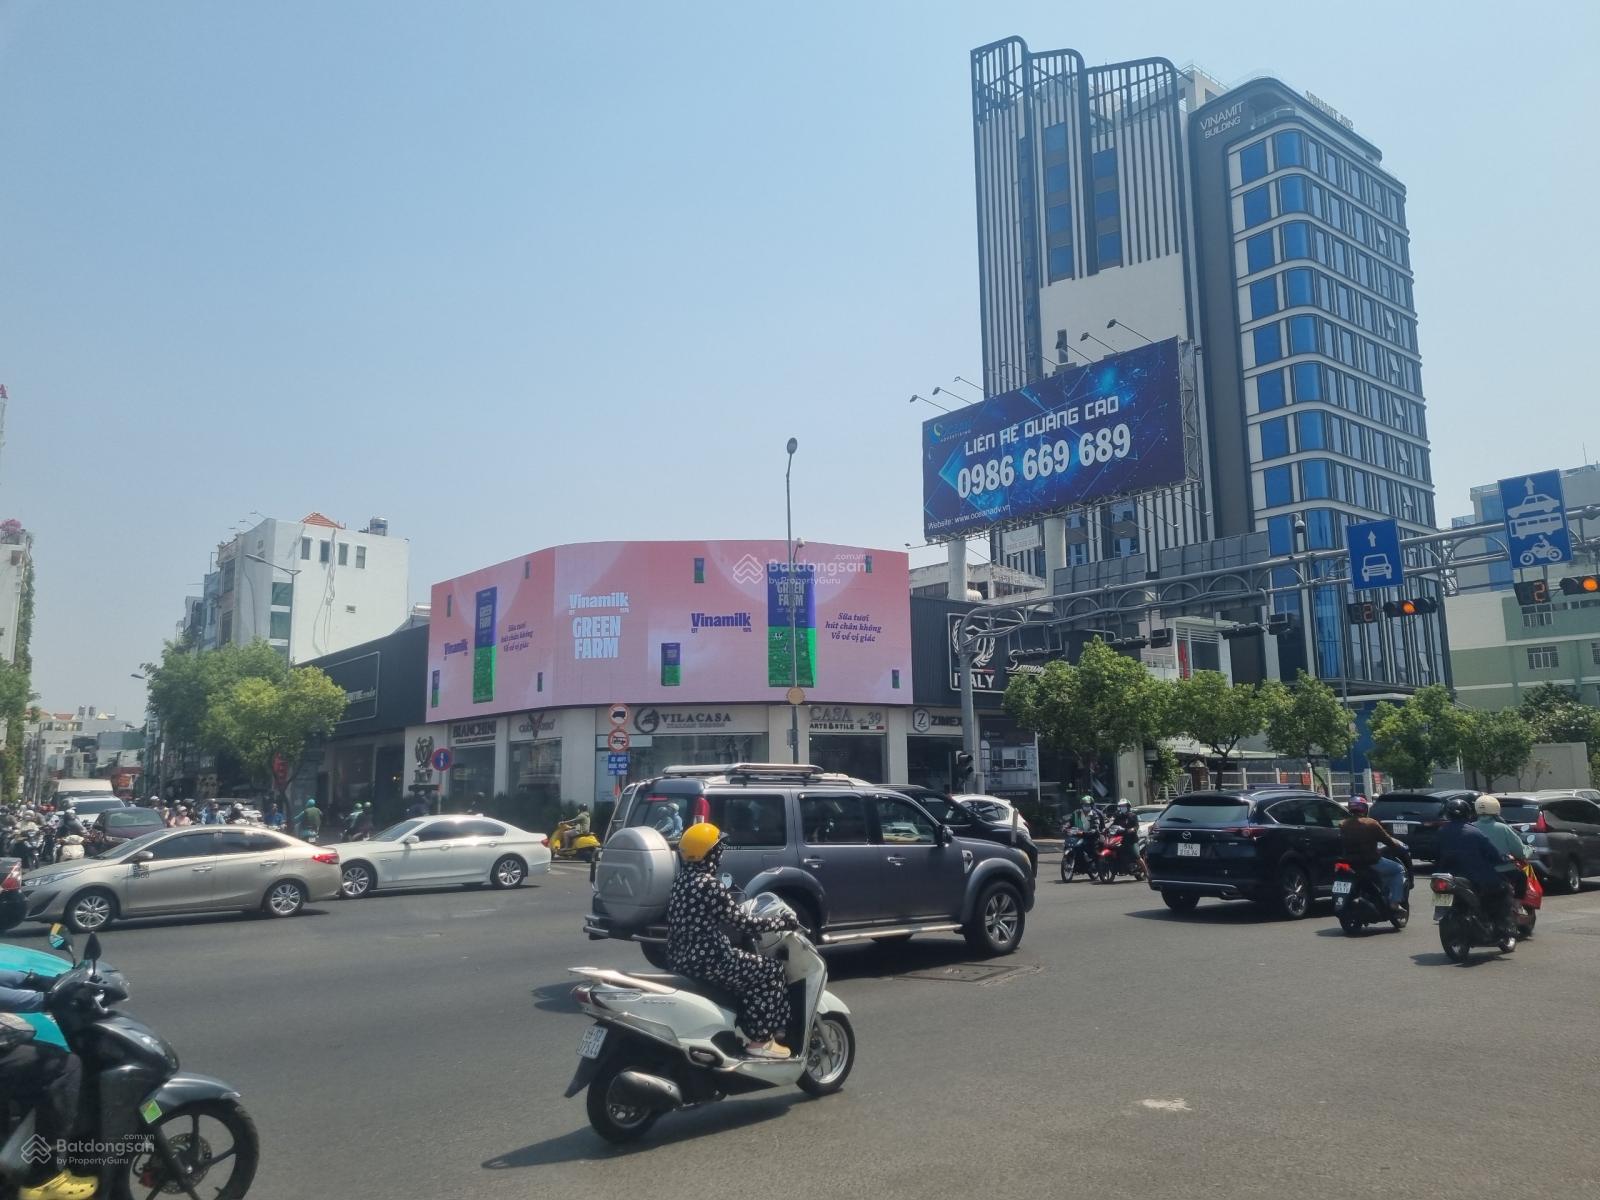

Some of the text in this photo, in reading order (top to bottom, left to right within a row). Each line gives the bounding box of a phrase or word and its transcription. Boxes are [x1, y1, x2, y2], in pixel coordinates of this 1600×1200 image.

[1200, 101, 1245, 130] VINAMIT
[1205, 114, 1240, 139] BUILDING
[965, 433, 995, 456] LIÊN
[999, 423, 1019, 446] HỆ
[1085, 396, 1119, 420] CÁO
[957, 423, 1131, 498] 0986 669 689
[569, 591, 629, 609] Vinamilk
[573, 615, 621, 638] GREEN
[691, 612, 751, 627] Vinamilk
[575, 637, 618, 659] FARM
[954, 672, 995, 688] IALY
[660, 712, 733, 723] VILACASA
